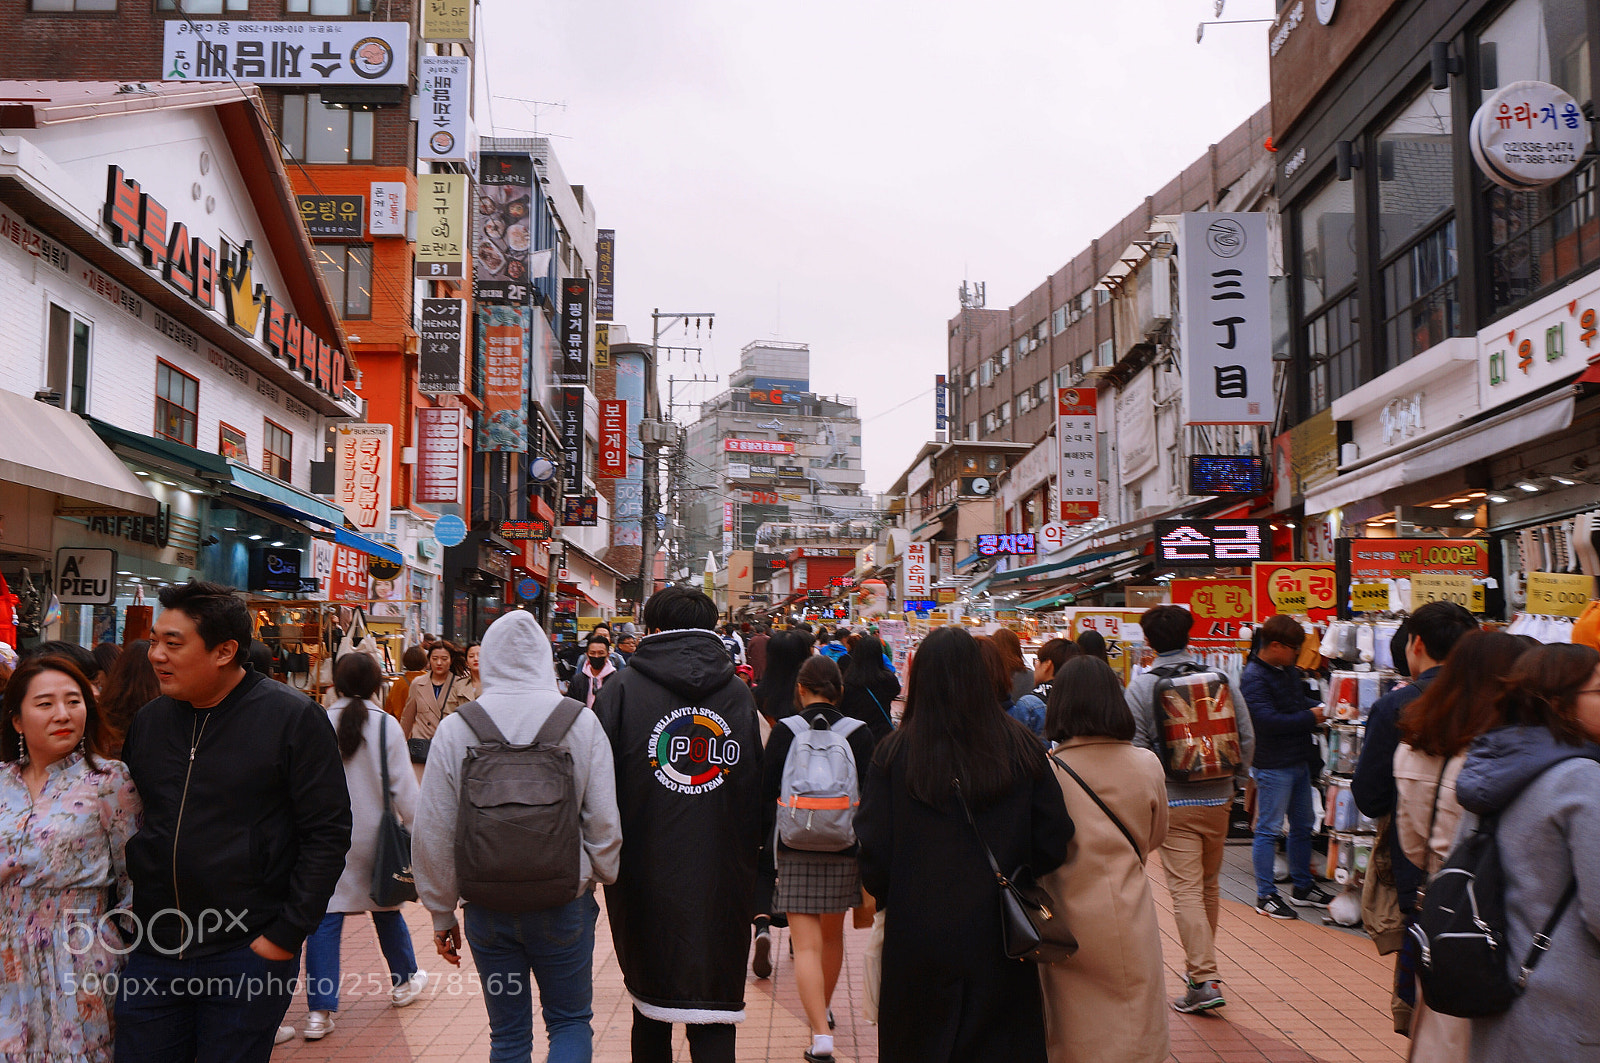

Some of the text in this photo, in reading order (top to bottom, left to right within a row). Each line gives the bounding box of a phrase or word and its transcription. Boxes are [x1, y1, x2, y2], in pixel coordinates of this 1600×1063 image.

[451, 7, 466, 16] 5F
[196, 41, 342, 78] 수제담배
[432, 76, 452, 128] 수제담배
[104, 165, 218, 311] 부루스타
[420, 243, 461, 257] 프렌즈
[431, 263, 448, 276] B1
[508, 284, 527, 300] 2F
[425, 304, 460, 316] ヘンナ
[422, 320, 460, 328] HENNA
[422, 331, 460, 340] TATTOO
[567, 302, 583, 363] 핑거뮤직
[1211, 268, 1248, 399] 三丁目
[264, 296, 345, 400] 즉석떡볶이
[1489, 308, 1598, 387] 미우미우
[604, 403, 622, 467] 보드게임
[1045, 526, 1066, 547] 약
[1160, 525, 1262, 560] 손금
[336, 545, 368, 588] 부동산
[1398, 545, 1478, 566] ₩1,000원
[60, 578, 107, 597] PIEU
[1197, 590, 1244, 615] 힐링
[1082, 618, 1119, 634] 힐링
[669, 736, 741, 766] POLO
[677, 785, 703, 795] POLO
[701, 772, 725, 793] TEAM
